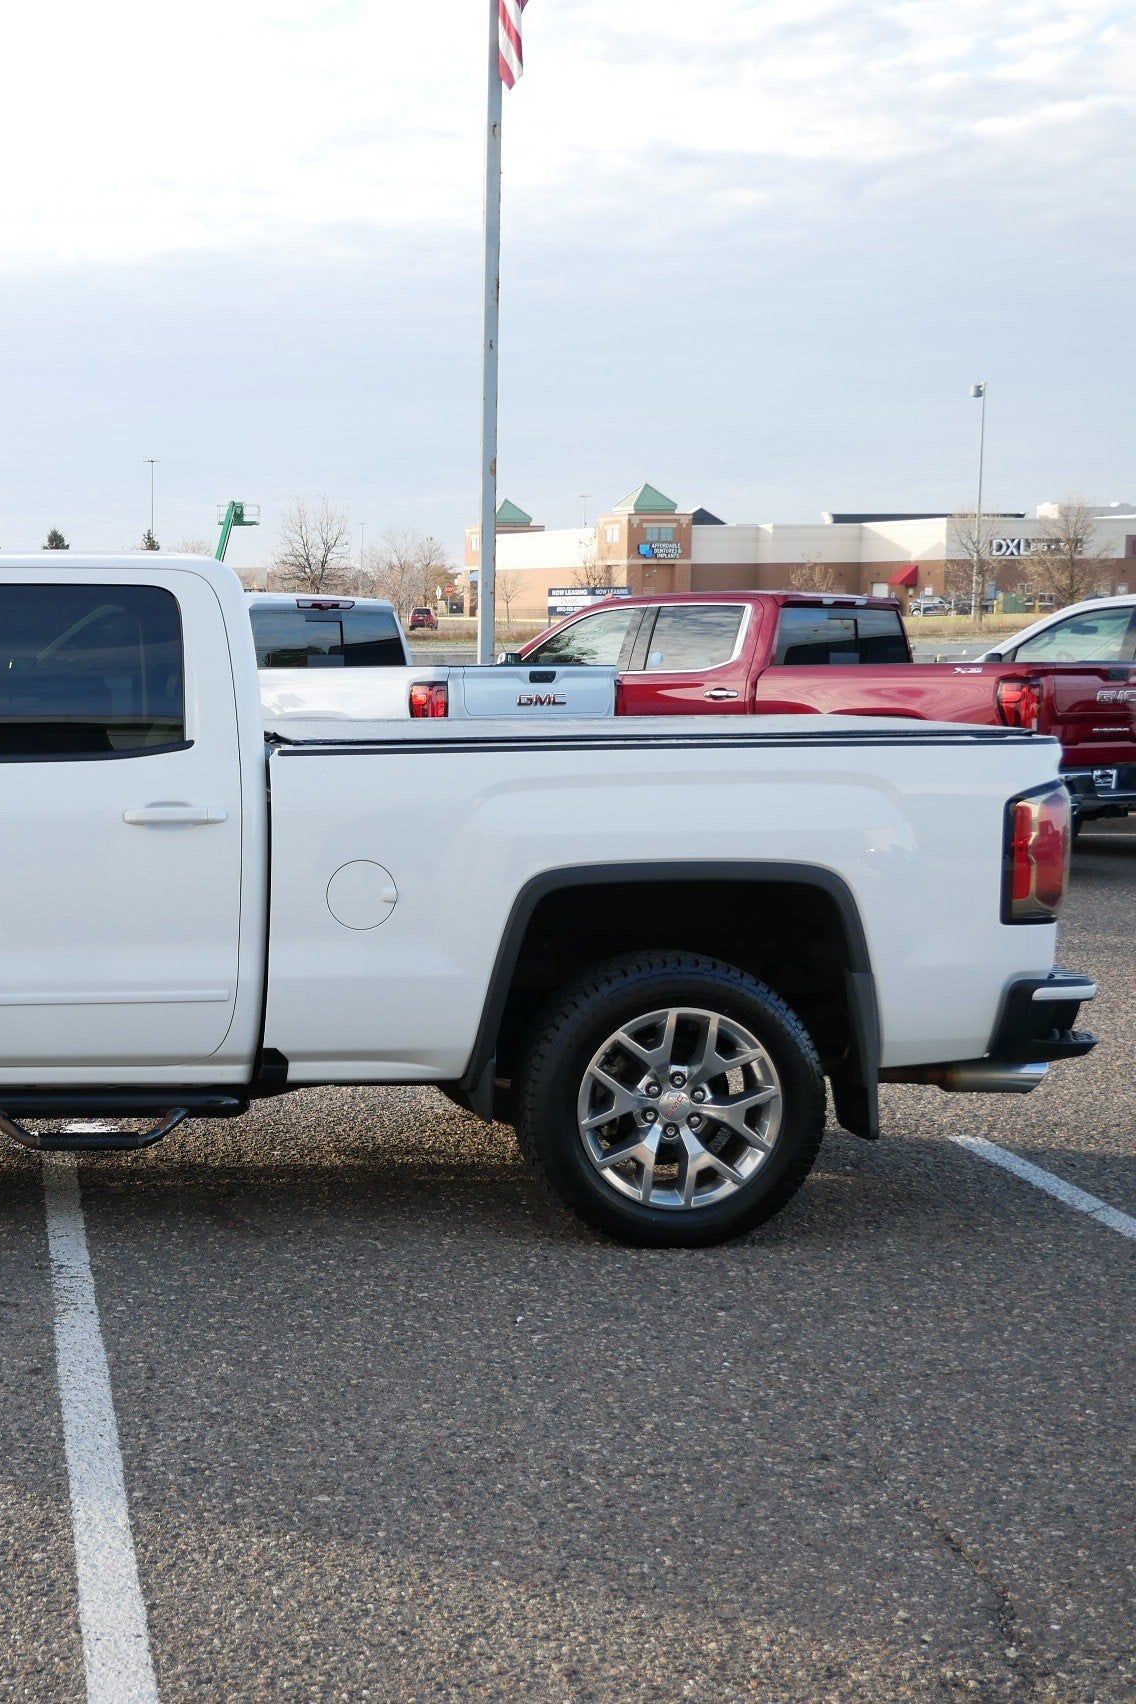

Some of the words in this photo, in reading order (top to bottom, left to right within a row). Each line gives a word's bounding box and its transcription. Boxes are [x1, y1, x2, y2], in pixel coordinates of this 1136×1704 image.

[991, 538, 1030, 556] DXL
[517, 692, 567, 706] GMC
[665, 1094, 684, 1118] GMC
